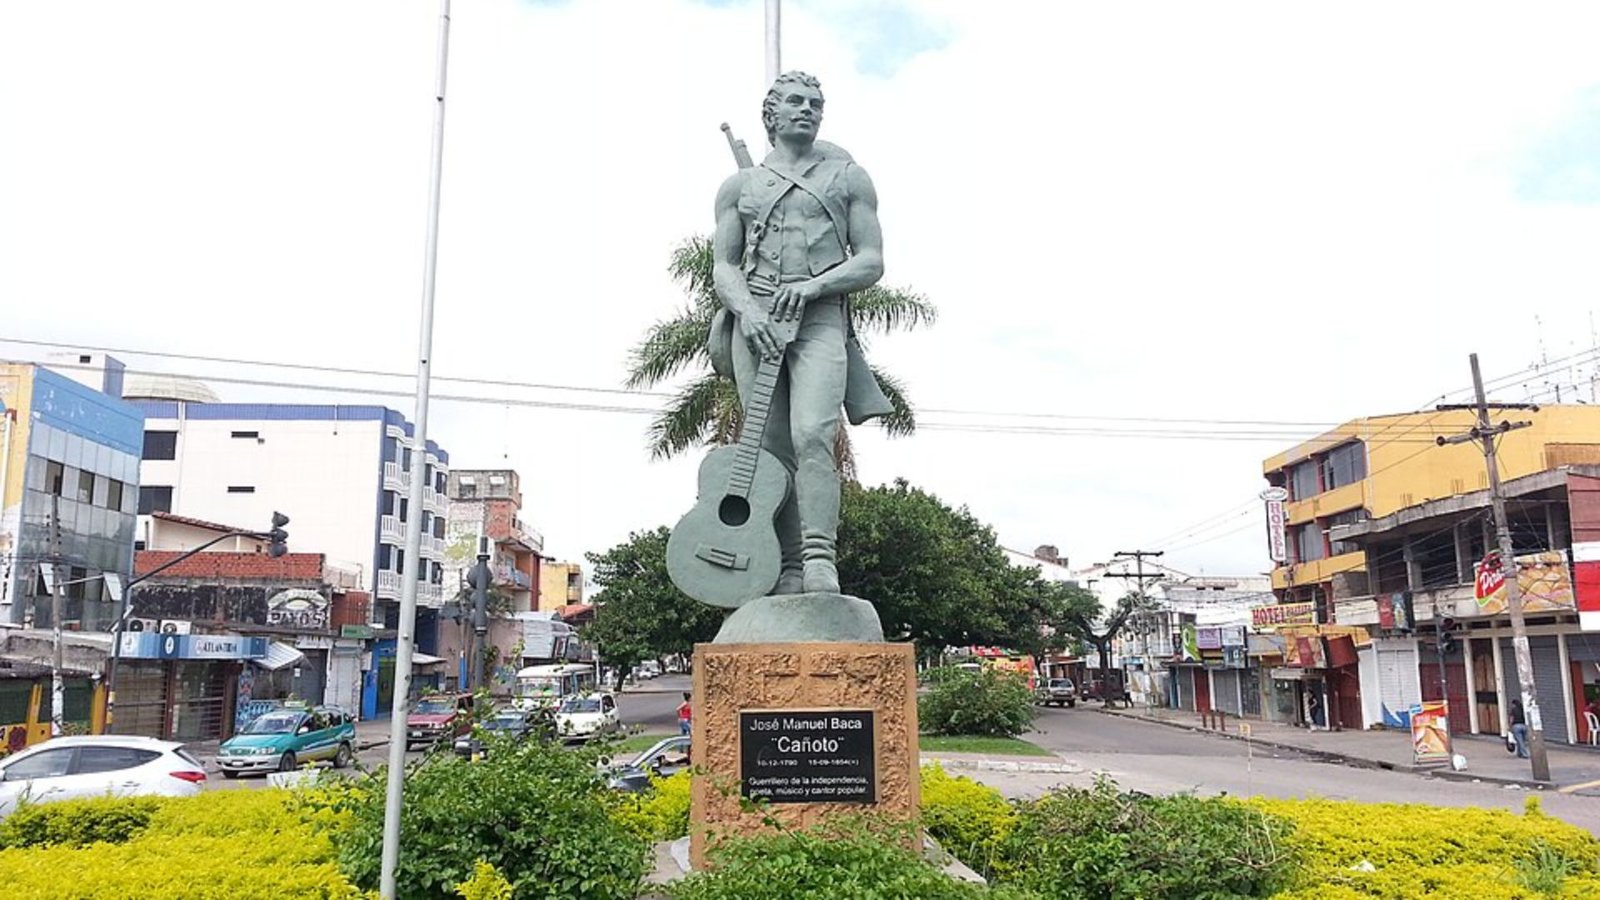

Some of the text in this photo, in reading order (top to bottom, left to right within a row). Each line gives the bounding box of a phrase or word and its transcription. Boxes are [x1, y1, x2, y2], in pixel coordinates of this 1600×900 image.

[1270, 502, 1284, 558] HOTEL
[1251, 606, 1285, 625] HOTEL
[750, 717, 862, 731] José Manuel Baca
[748, 776, 789, 786] Guerrillero
[791, 776, 801, 785] de
[802, 776, 810, 785] la
[775, 786, 804, 796] músico
[804, 788, 810, 796] y
[811, 787, 836, 795] cantor
